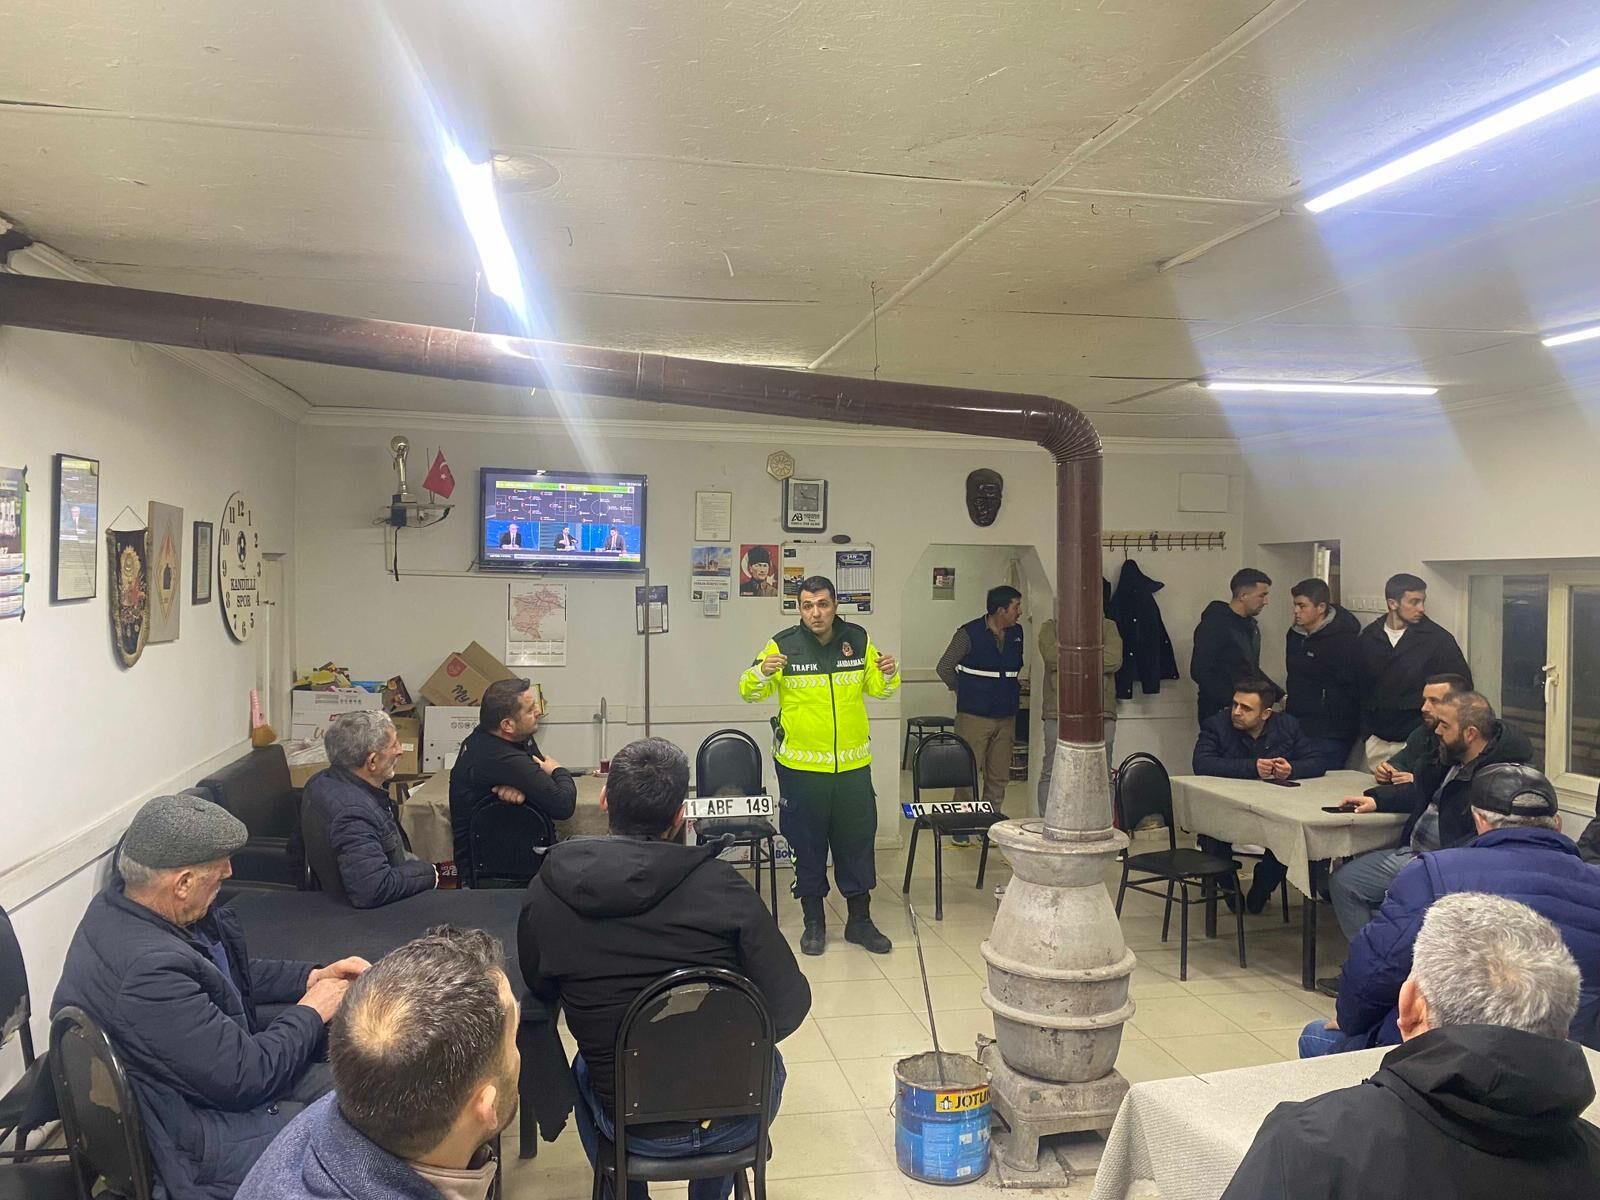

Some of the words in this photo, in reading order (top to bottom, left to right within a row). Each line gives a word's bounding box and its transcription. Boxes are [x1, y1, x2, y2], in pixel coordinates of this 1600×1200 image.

[229, 506, 236, 524] 11
[237, 500, 245, 517] 12
[222, 528, 230, 546] 10
[222, 559, 227, 577] 9
[256, 562, 262, 577] 3
[237, 595, 251, 607] SPOR
[684, 801, 697, 816] 11
[707, 799, 734, 816] ABF
[746, 798, 770, 813] 149
[912, 804, 926, 817] 11
